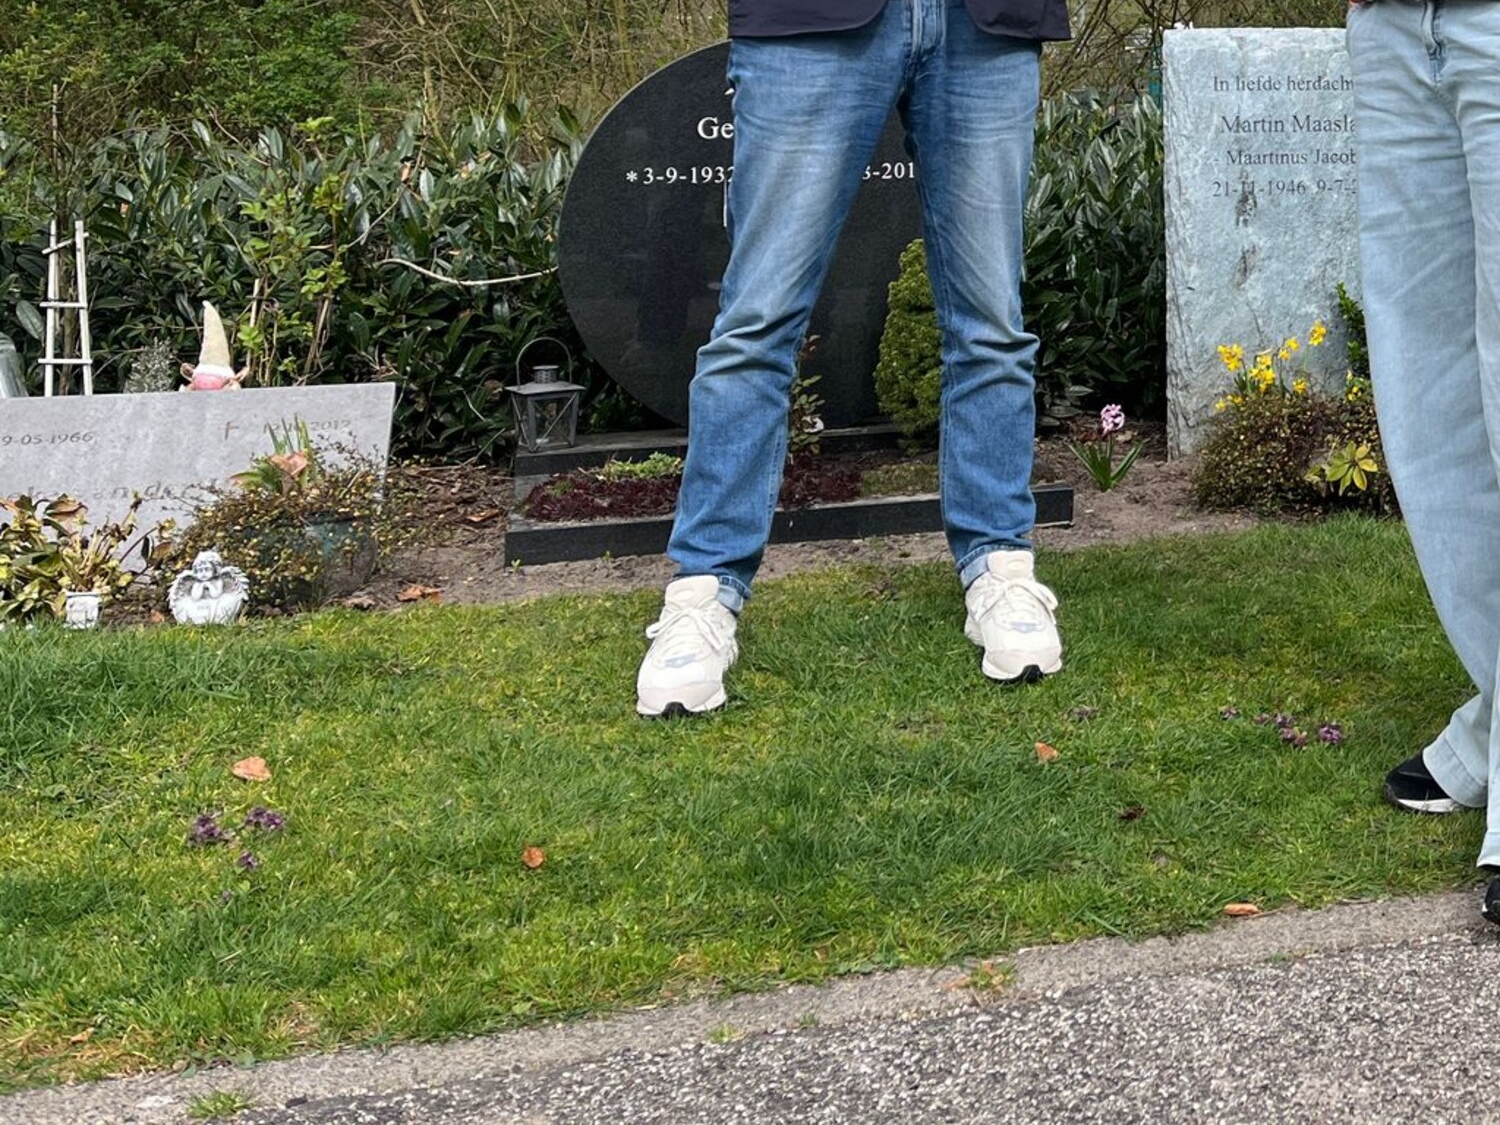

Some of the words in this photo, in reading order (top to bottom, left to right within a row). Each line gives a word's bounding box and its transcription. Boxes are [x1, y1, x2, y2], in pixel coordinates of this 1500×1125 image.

[1213, 75, 1230, 92] In
[1236, 75, 1281, 91] liefde
[697, 116, 735, 140] Ge
[1221, 114, 1285, 133] Martin
[1226, 150, 1309, 165] Maartinus
